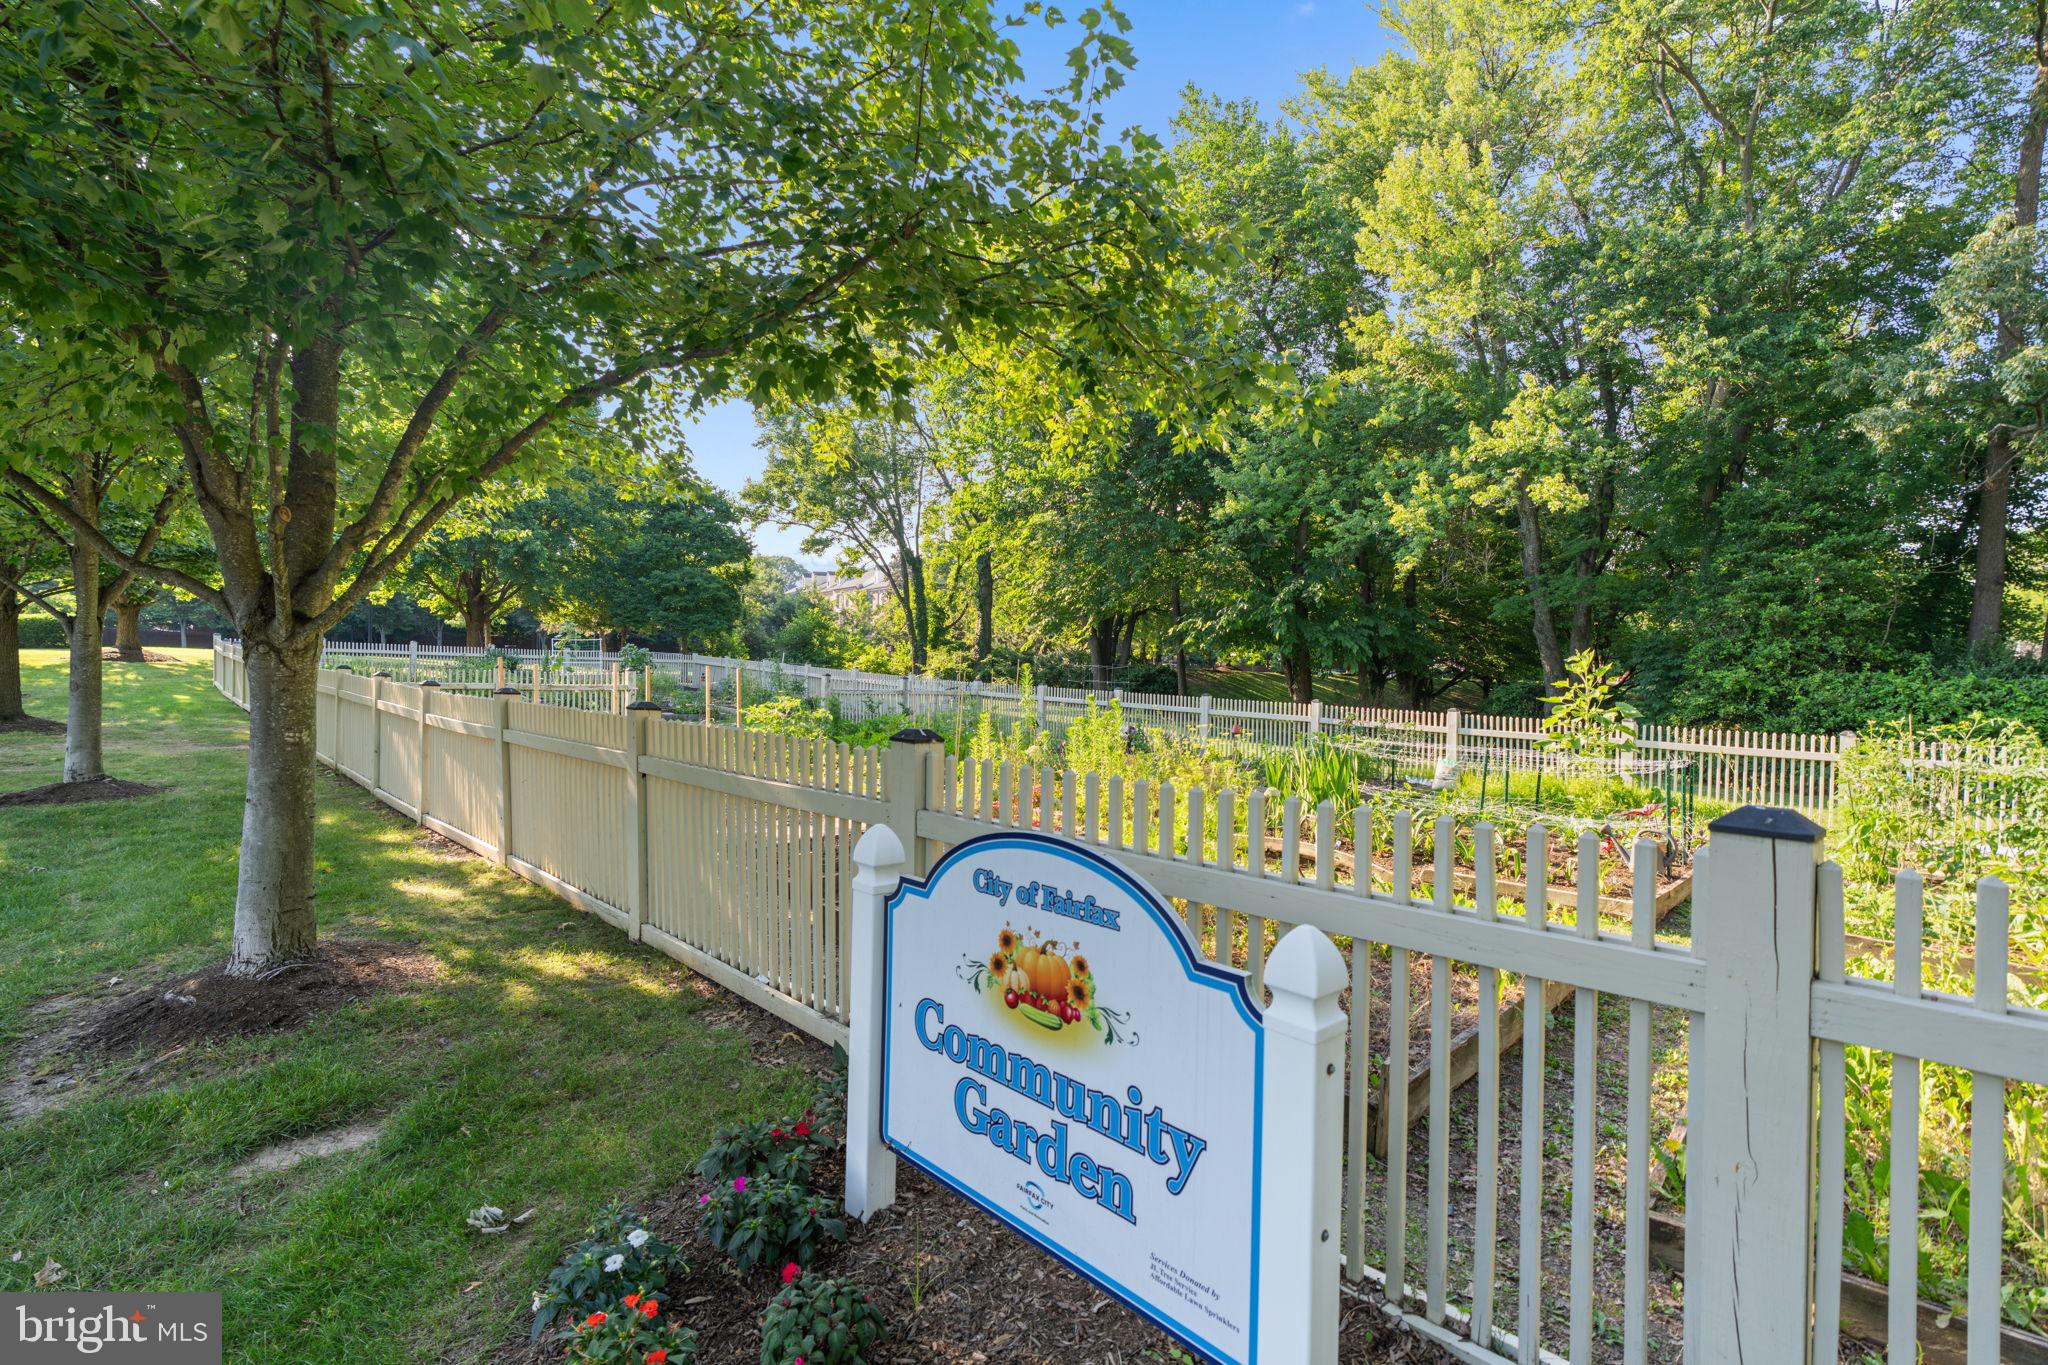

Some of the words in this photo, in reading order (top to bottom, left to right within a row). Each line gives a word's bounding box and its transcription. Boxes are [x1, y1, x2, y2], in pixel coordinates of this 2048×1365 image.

[973, 868, 1013, 907] City
[1016, 880, 1040, 908] of
[1041, 884, 1120, 932] Fairfax
[914, 997, 1207, 1195] Community
[954, 1077, 1137, 1226] Garden
[1016, 1183, 1040, 1202] FAIRFAX
[1040, 1198, 1054, 1210] CITY
[1149, 1252, 1178, 1275] Services
[1179, 1270, 1210, 1294] Donated
[1211, 1288, 1221, 1301] by
[1149, 1273, 1183, 1298] Affordable
[1184, 1293, 1203, 1311] Lawn
[1204, 1305, 1240, 1334] Sprinklers
[1159, 1267, 1173, 1282] Tree
[1174, 1278, 1198, 1297] Service
